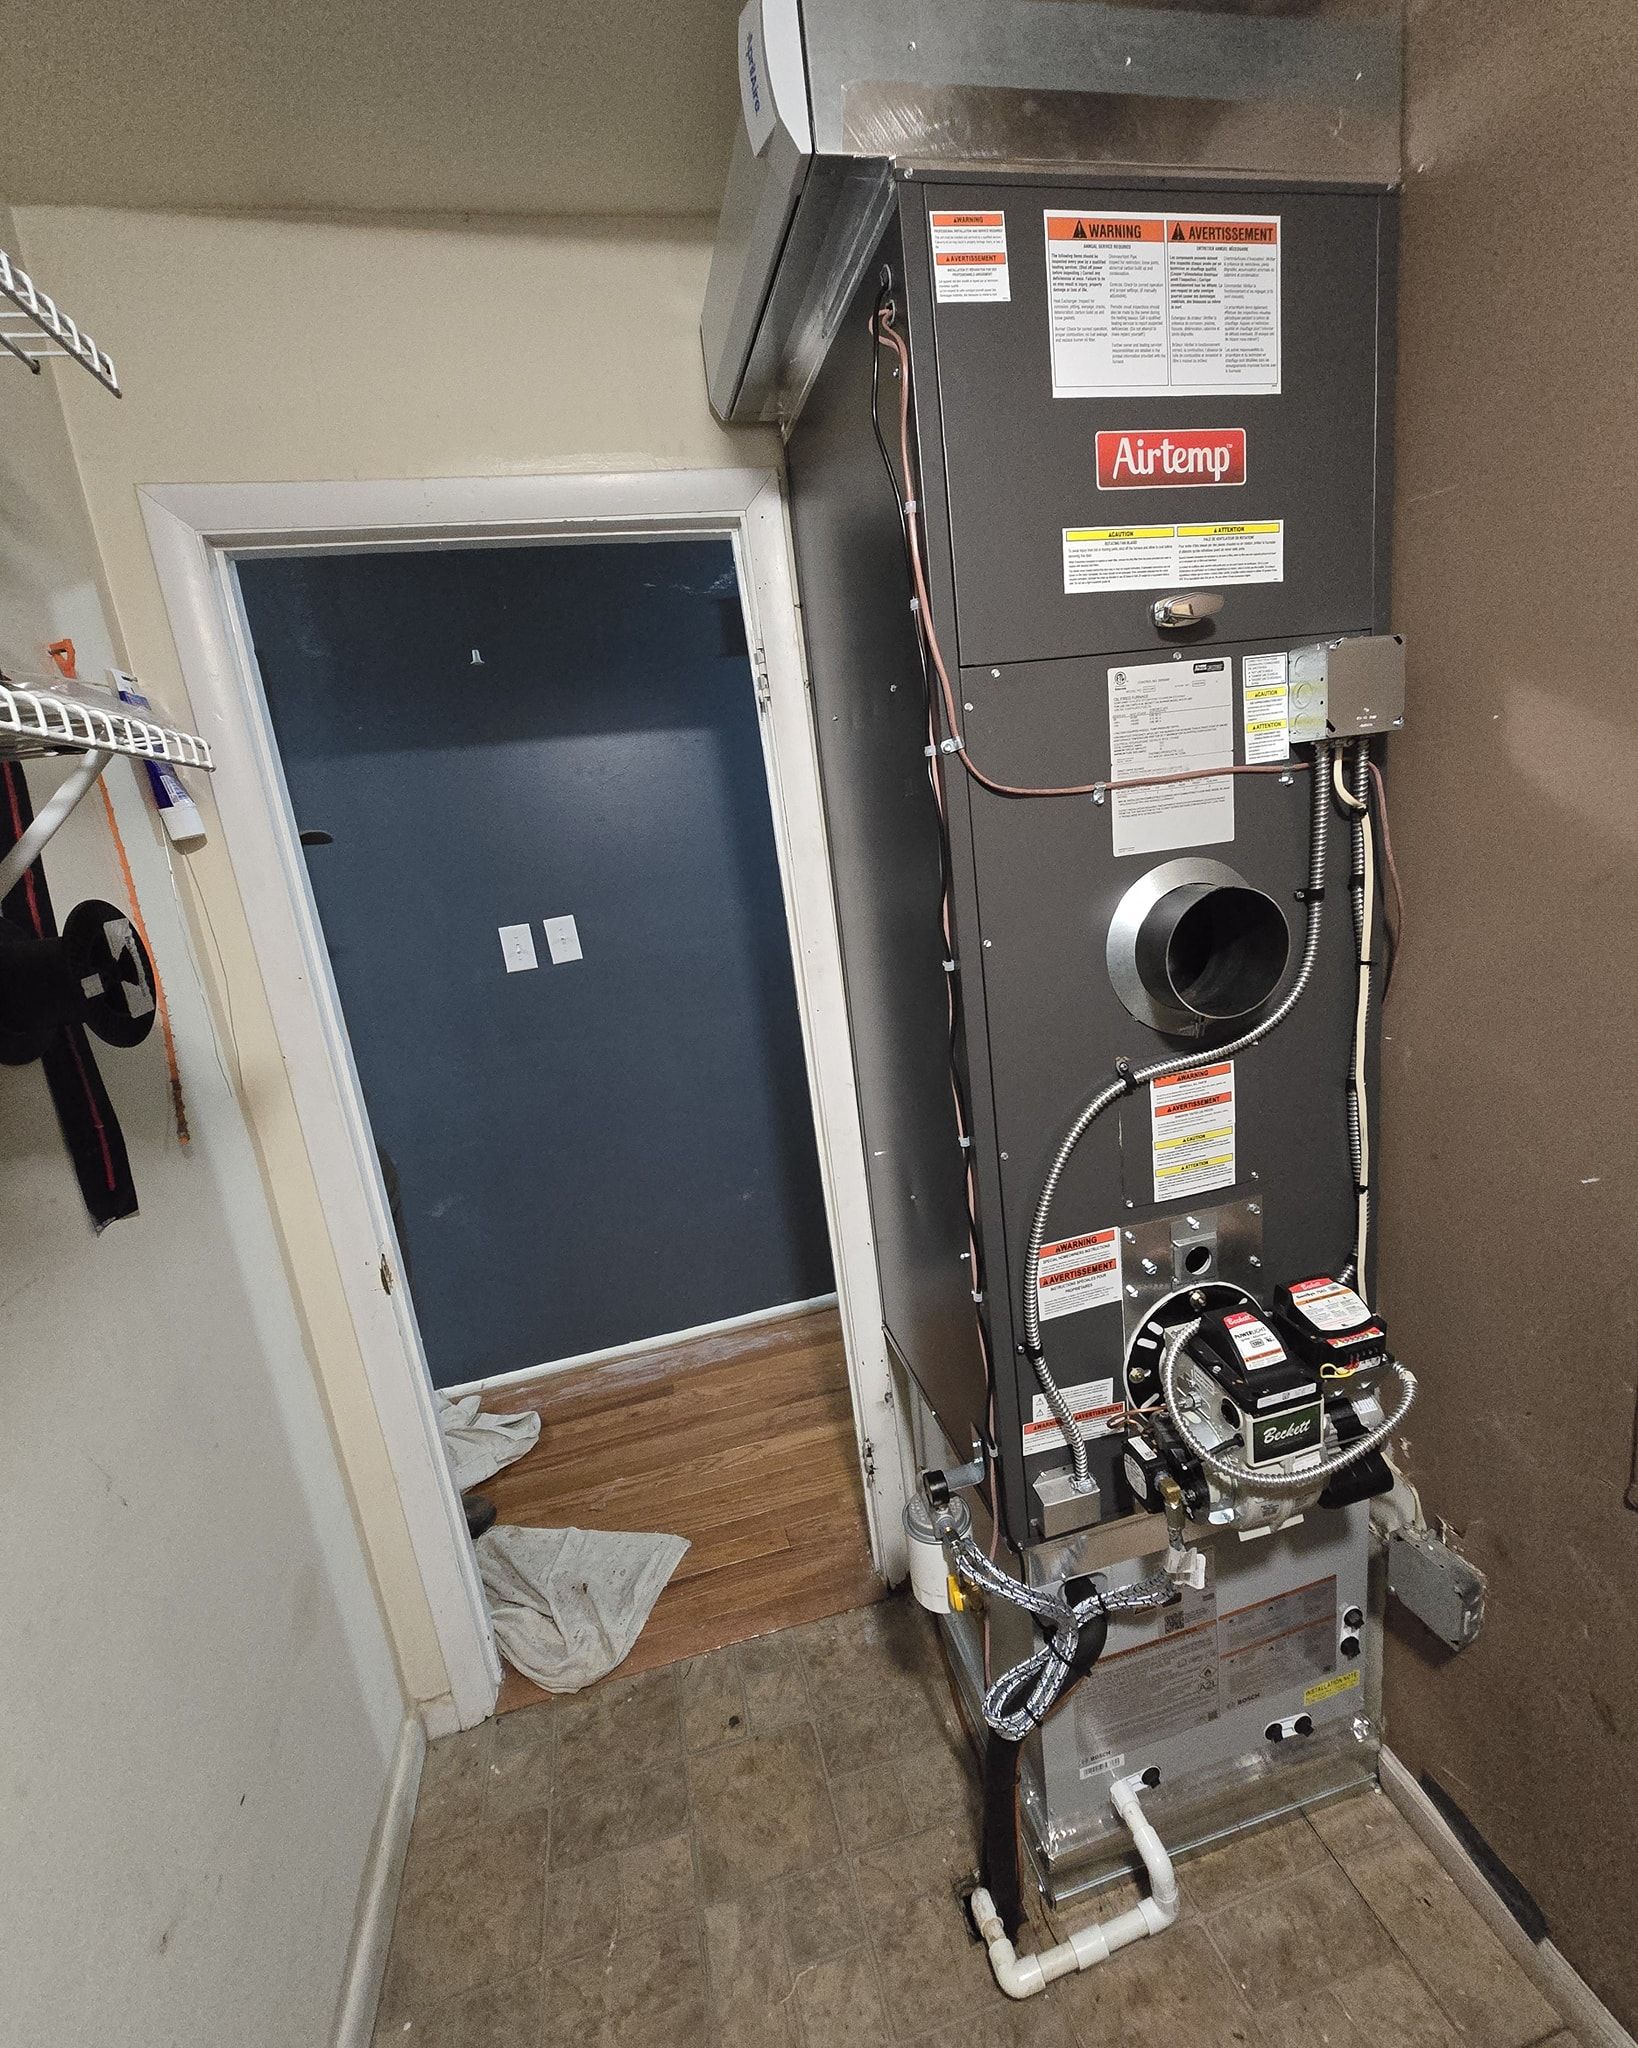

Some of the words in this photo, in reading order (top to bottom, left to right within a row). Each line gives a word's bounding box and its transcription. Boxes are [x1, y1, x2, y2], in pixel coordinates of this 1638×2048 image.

[957, 216, 984, 224] WARNING
[1088, 224, 1142, 239] WARNING
[1189, 226, 1274, 242] AVERTISSEMENT
[1112, 437, 1230, 482] Airtemp
[1256, 722, 1281, 730] ATTENTION
[1181, 1070, 1208, 1080] WARNING
[1172, 1096, 1220, 1112] AVERTISSEMENT
[1186, 1134, 1206, 1142] CAUTION
[1185, 1161, 1208, 1169] ATTENTION
[1060, 1236, 1097, 1252] WARNING
[1049, 1261, 1113, 1284] AVERTISSEMENT
[1228, 1315, 1252, 1326] Beckett
[1234, 1327, 1266, 1339] POWERLIGHT
[1263, 1420, 1311, 1444] Beckett
[1237, 1693, 1261, 1704] BOSCH
